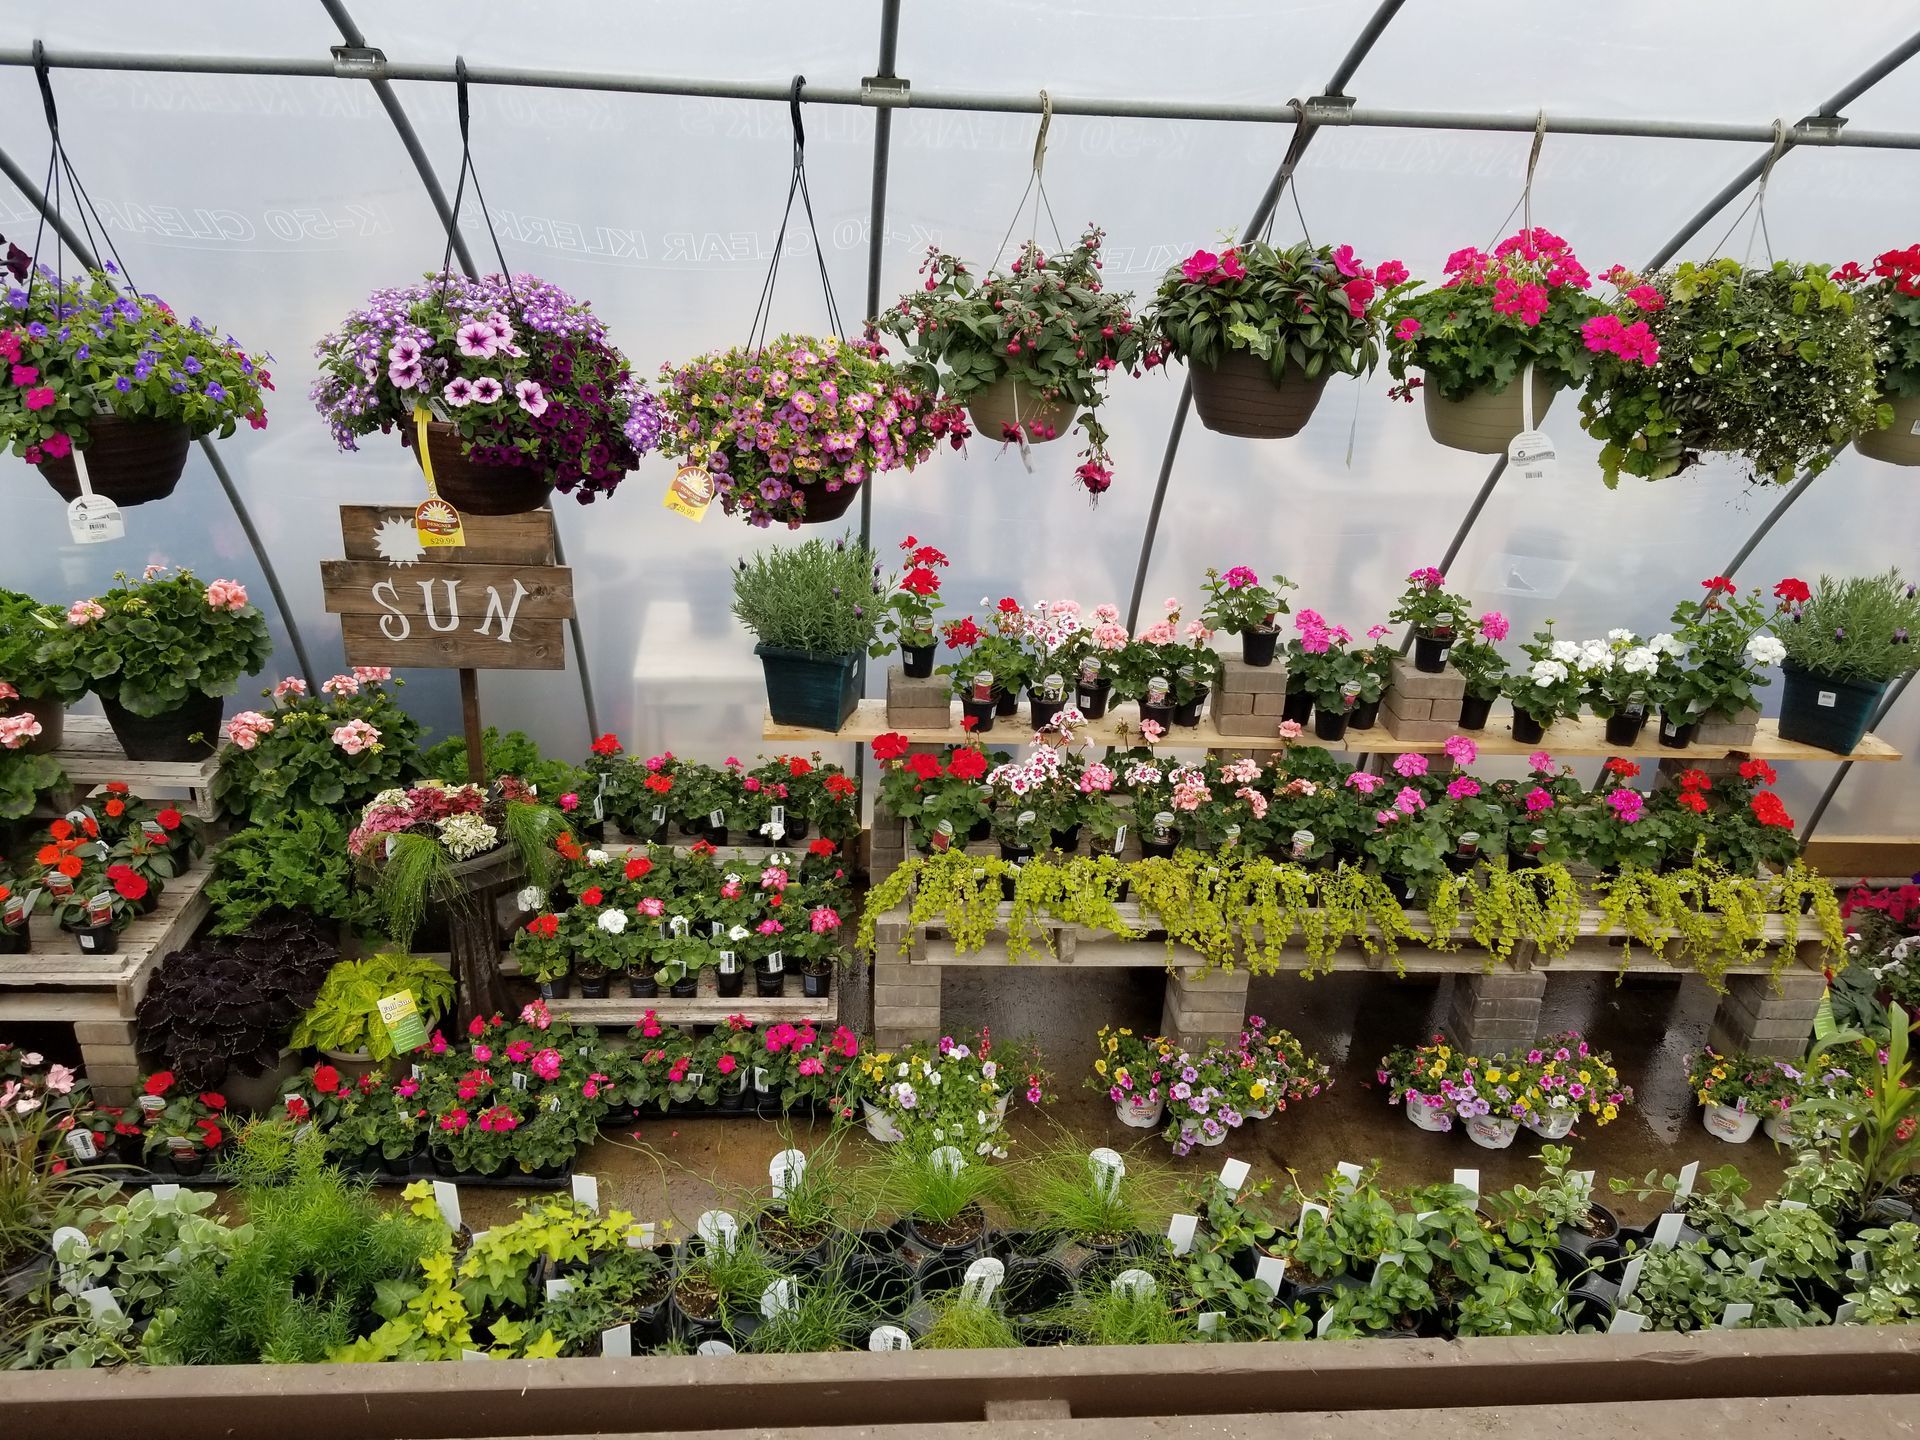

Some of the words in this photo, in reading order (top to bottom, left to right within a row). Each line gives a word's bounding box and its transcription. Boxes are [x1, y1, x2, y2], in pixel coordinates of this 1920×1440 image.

[430, 537, 456, 545] $29.99
[371, 577, 530, 643] SUN
[382, 1002, 397, 1014] Full
[397, 999, 412, 1007] Sun
